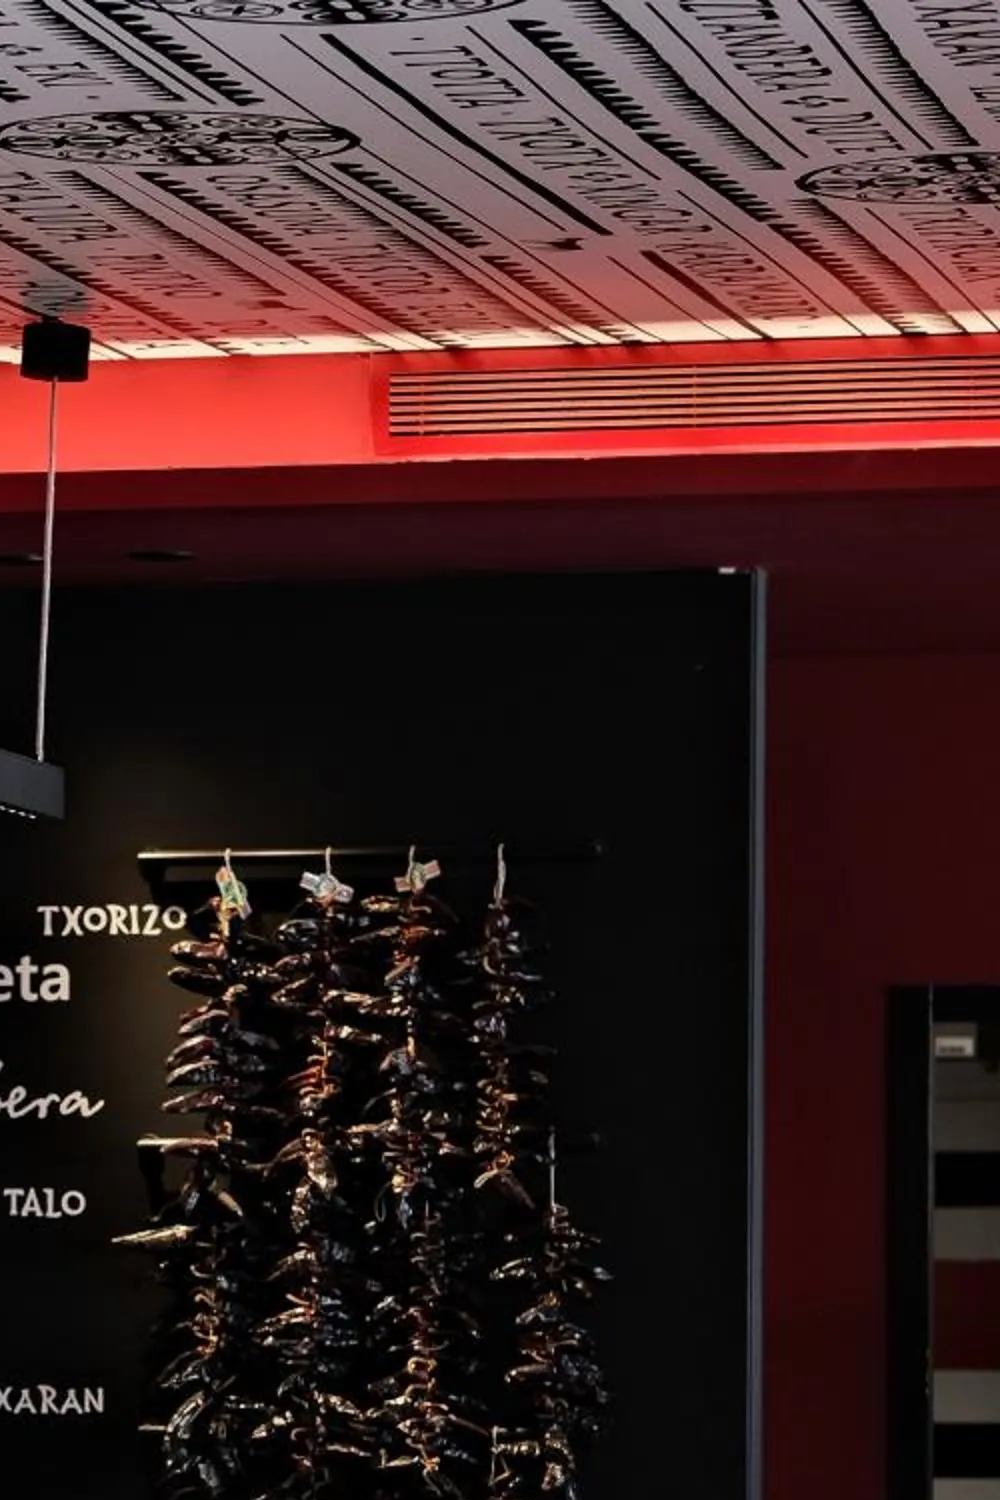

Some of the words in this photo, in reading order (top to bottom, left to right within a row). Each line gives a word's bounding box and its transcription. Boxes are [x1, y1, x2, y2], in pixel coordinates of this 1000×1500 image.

[477, 117, 603, 171] TXOTX
[206, 174, 360, 240] OSASUNA
[37, 904, 187, 936] TXORIZO
[3, 1188, 87, 1218] TALO
